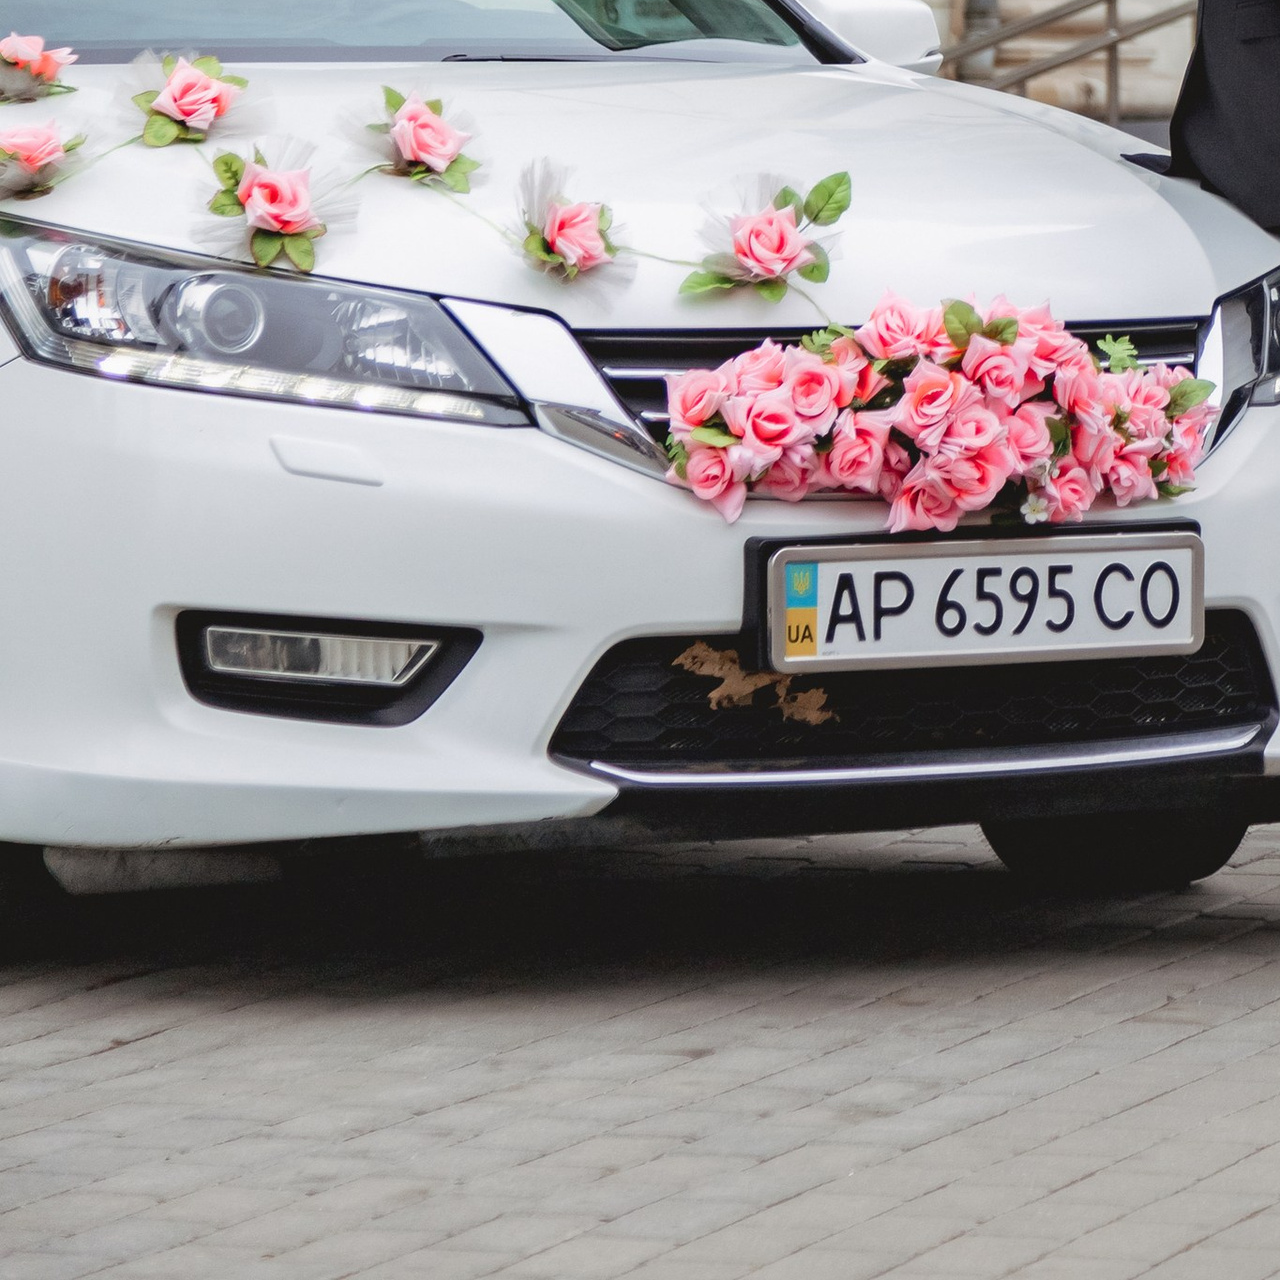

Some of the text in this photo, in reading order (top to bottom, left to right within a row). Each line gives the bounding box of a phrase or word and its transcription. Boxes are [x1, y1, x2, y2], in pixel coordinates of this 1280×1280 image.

[825, 561, 1180, 643] AP 6595 CO
[788, 625, 814, 643] UA
